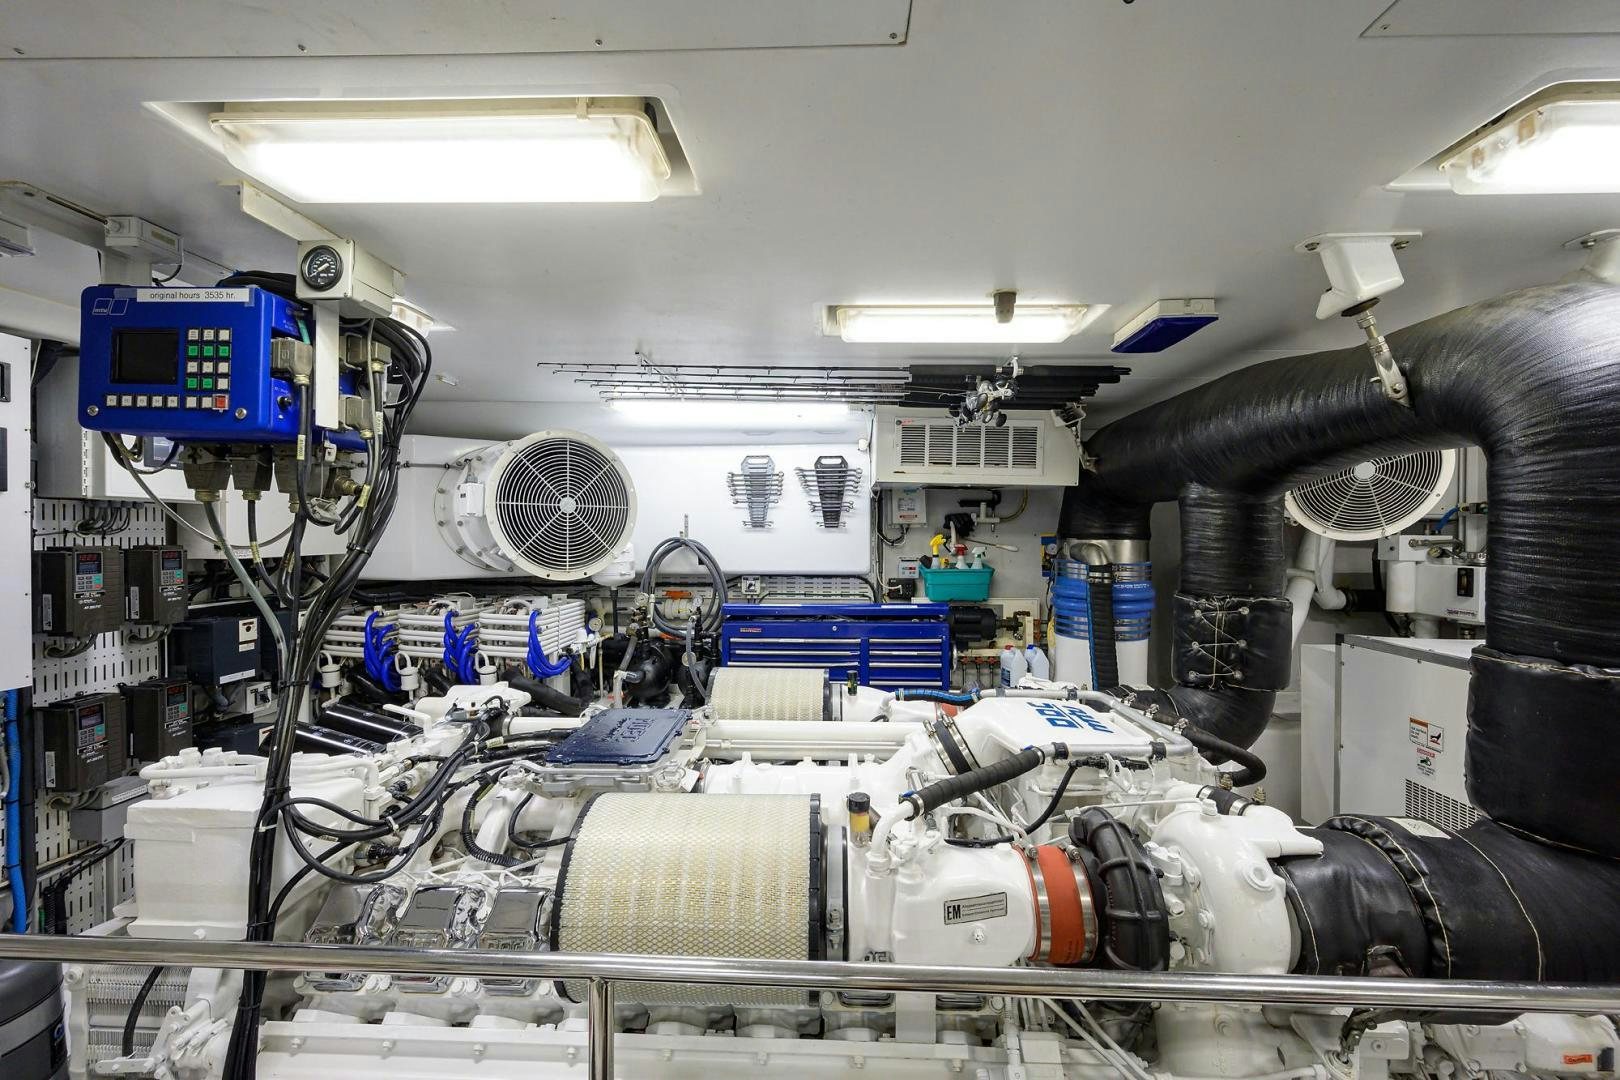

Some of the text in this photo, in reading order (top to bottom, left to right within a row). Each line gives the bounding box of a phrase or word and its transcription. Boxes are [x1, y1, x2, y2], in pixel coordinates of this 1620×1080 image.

[150, 288, 236, 299] original hours 3535 hr.
[946, 904, 961, 920] EM
